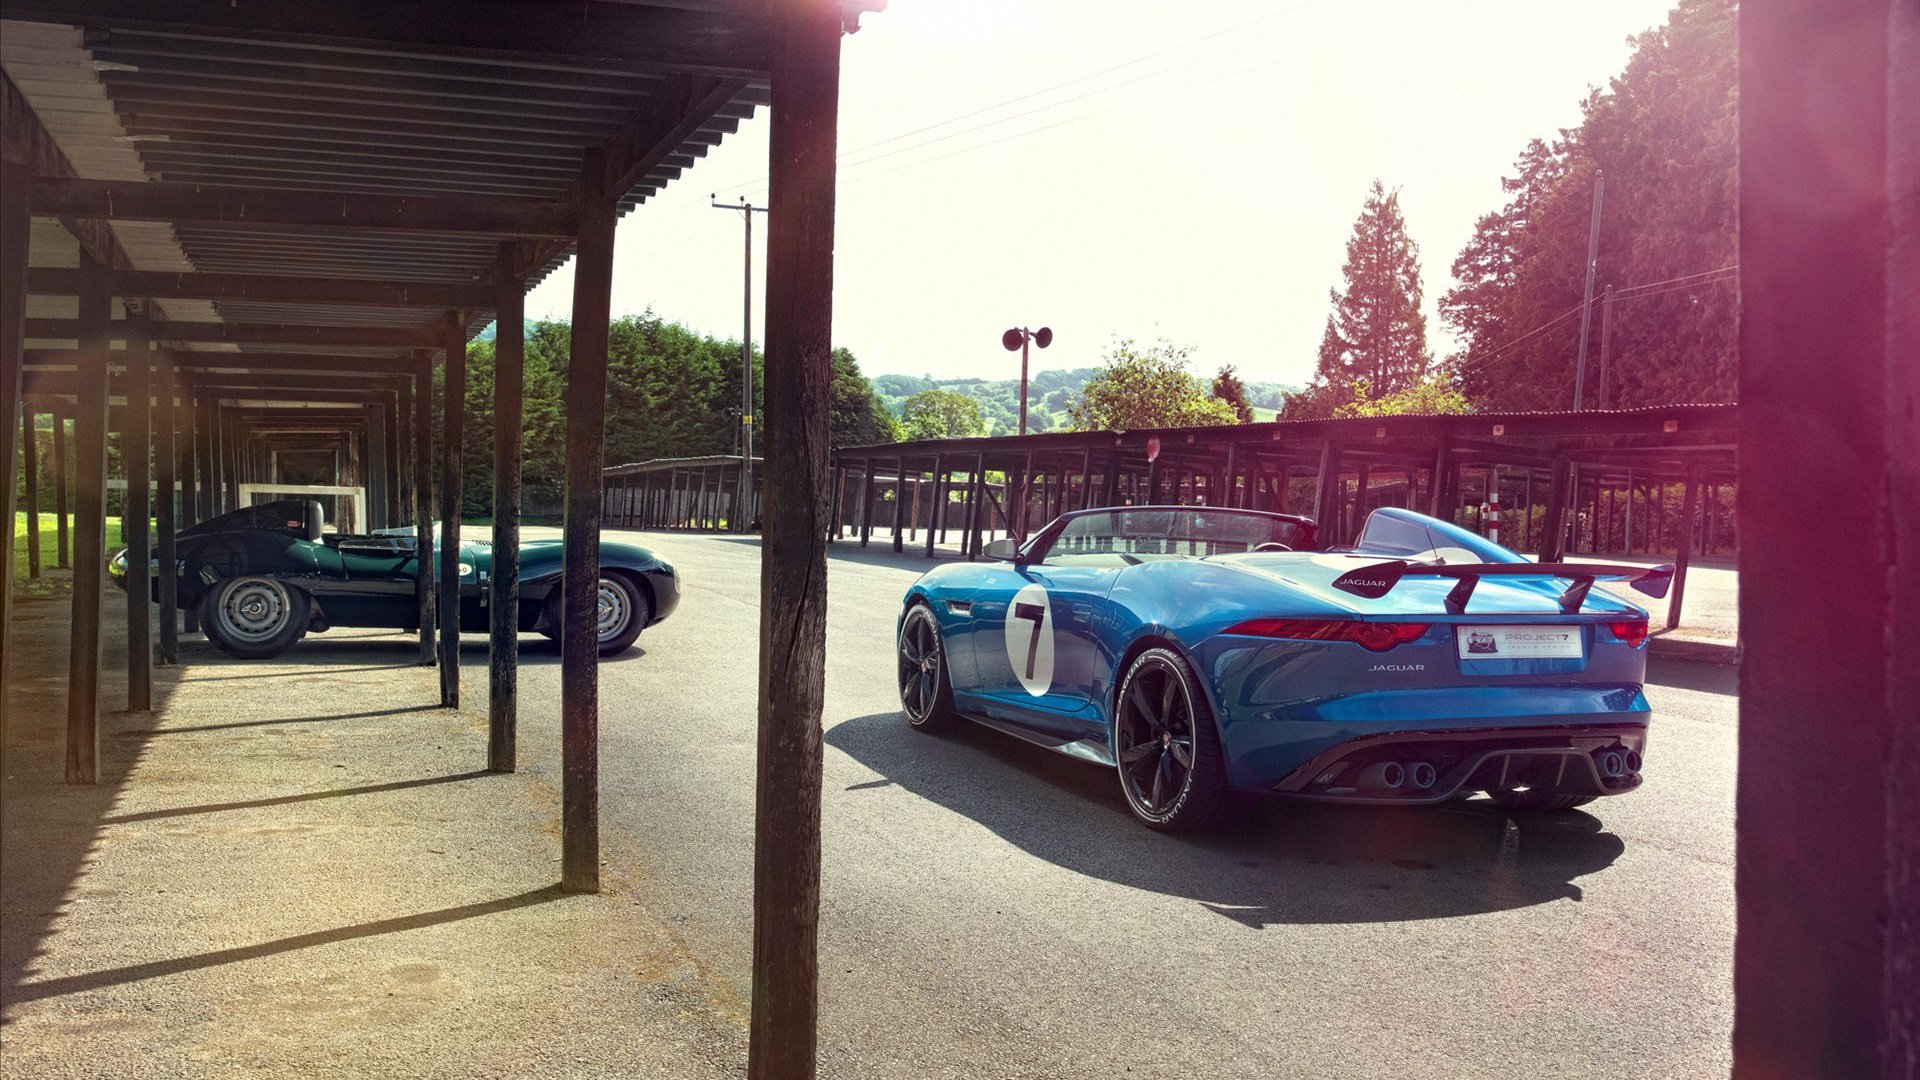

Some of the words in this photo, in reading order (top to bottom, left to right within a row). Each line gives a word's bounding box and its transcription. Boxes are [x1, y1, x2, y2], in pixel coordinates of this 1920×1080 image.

[1340, 579, 1386, 587] JAGUAR
[1015, 602, 1046, 680] 7
[1161, 770, 1192, 824] JAGUAR
